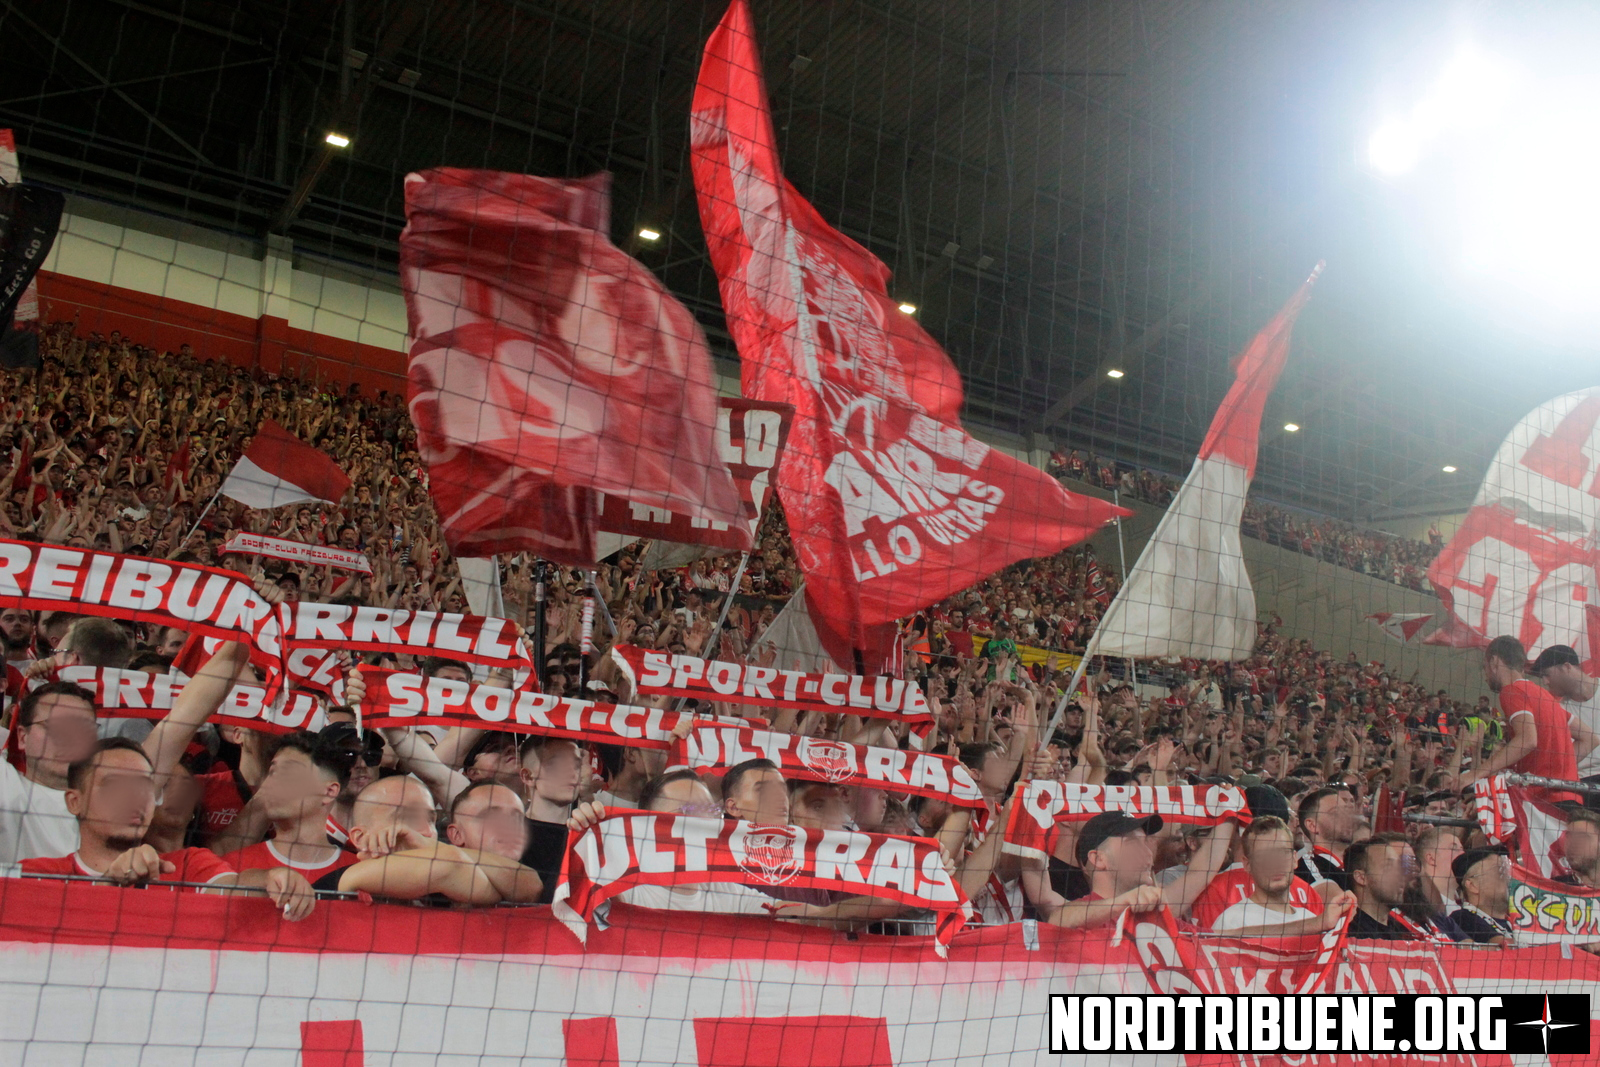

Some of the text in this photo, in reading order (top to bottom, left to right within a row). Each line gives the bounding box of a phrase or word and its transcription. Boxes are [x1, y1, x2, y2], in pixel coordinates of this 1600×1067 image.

[241, 538, 298, 554] SPORT-CLUB
[300, 548, 345, 562] FREIBURG
[640, 651, 930, 715] SPORT-CLUB
